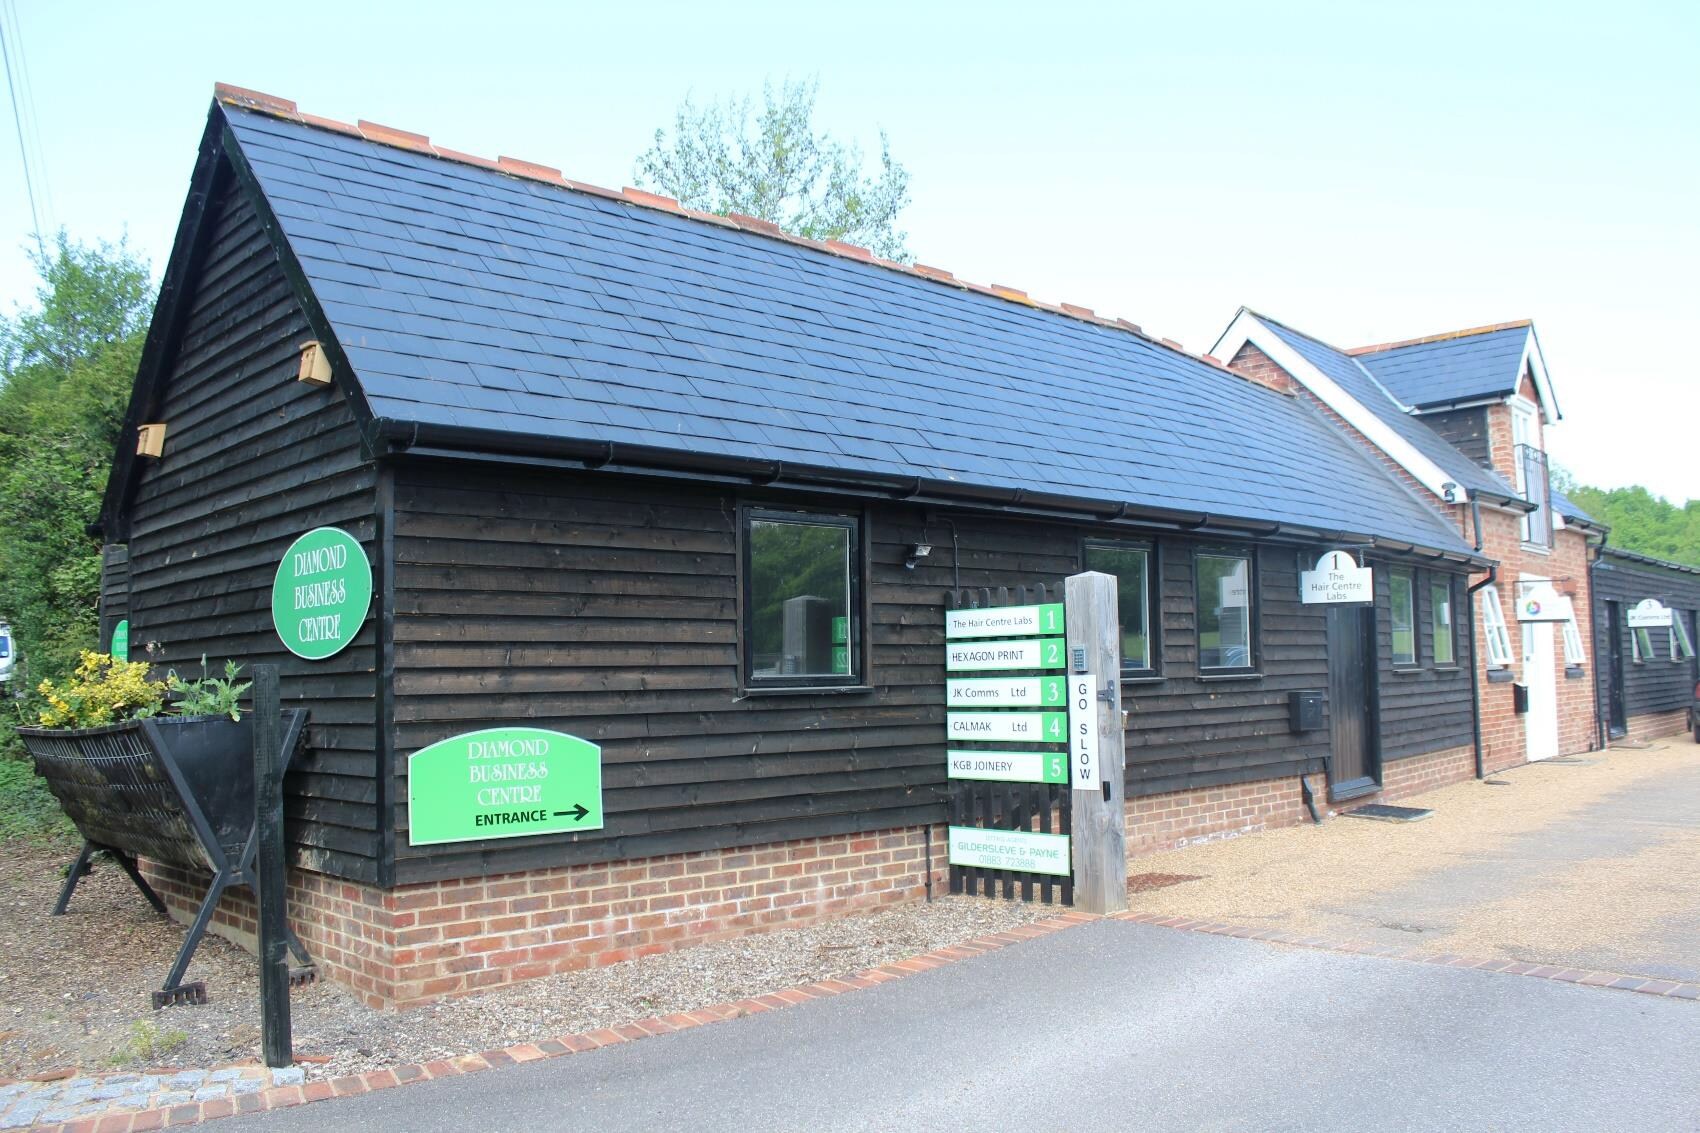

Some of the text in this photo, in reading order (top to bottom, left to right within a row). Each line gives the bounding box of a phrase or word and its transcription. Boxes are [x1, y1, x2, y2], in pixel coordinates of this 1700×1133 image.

[294, 544, 346, 577] DIAMOND
[1331, 553, 1339, 570] 1
[1311, 582, 1362, 591] Hair Centre
[1328, 573, 1344, 581] The
[294, 578, 346, 610] BUSINESS
[1326, 591, 1347, 601] Labs
[298, 613, 341, 642] CENTRE
[953, 610, 1056, 630] The Hair Centre Labs 1
[952, 644, 1058, 663] HEXAGON PRINT 2
[952, 682, 1059, 702] JK Comms Ltd 3
[953, 717, 1060, 737] CALMAK Ltd 4
[1078, 683, 1090, 780] GO SLOW
[467, 739, 548, 760] DIAMOND
[469, 762, 548, 783] BUSINESS
[953, 758, 1061, 778] KGB JOINERY 5
[477, 785, 542, 806] CENTRE
[475, 810, 548, 826] ENTRANCE
[958, 841, 1017, 856] GILDERSLEVE
[1029, 847, 1060, 859] PAYNE
[978, 854, 1002, 866] 01883
